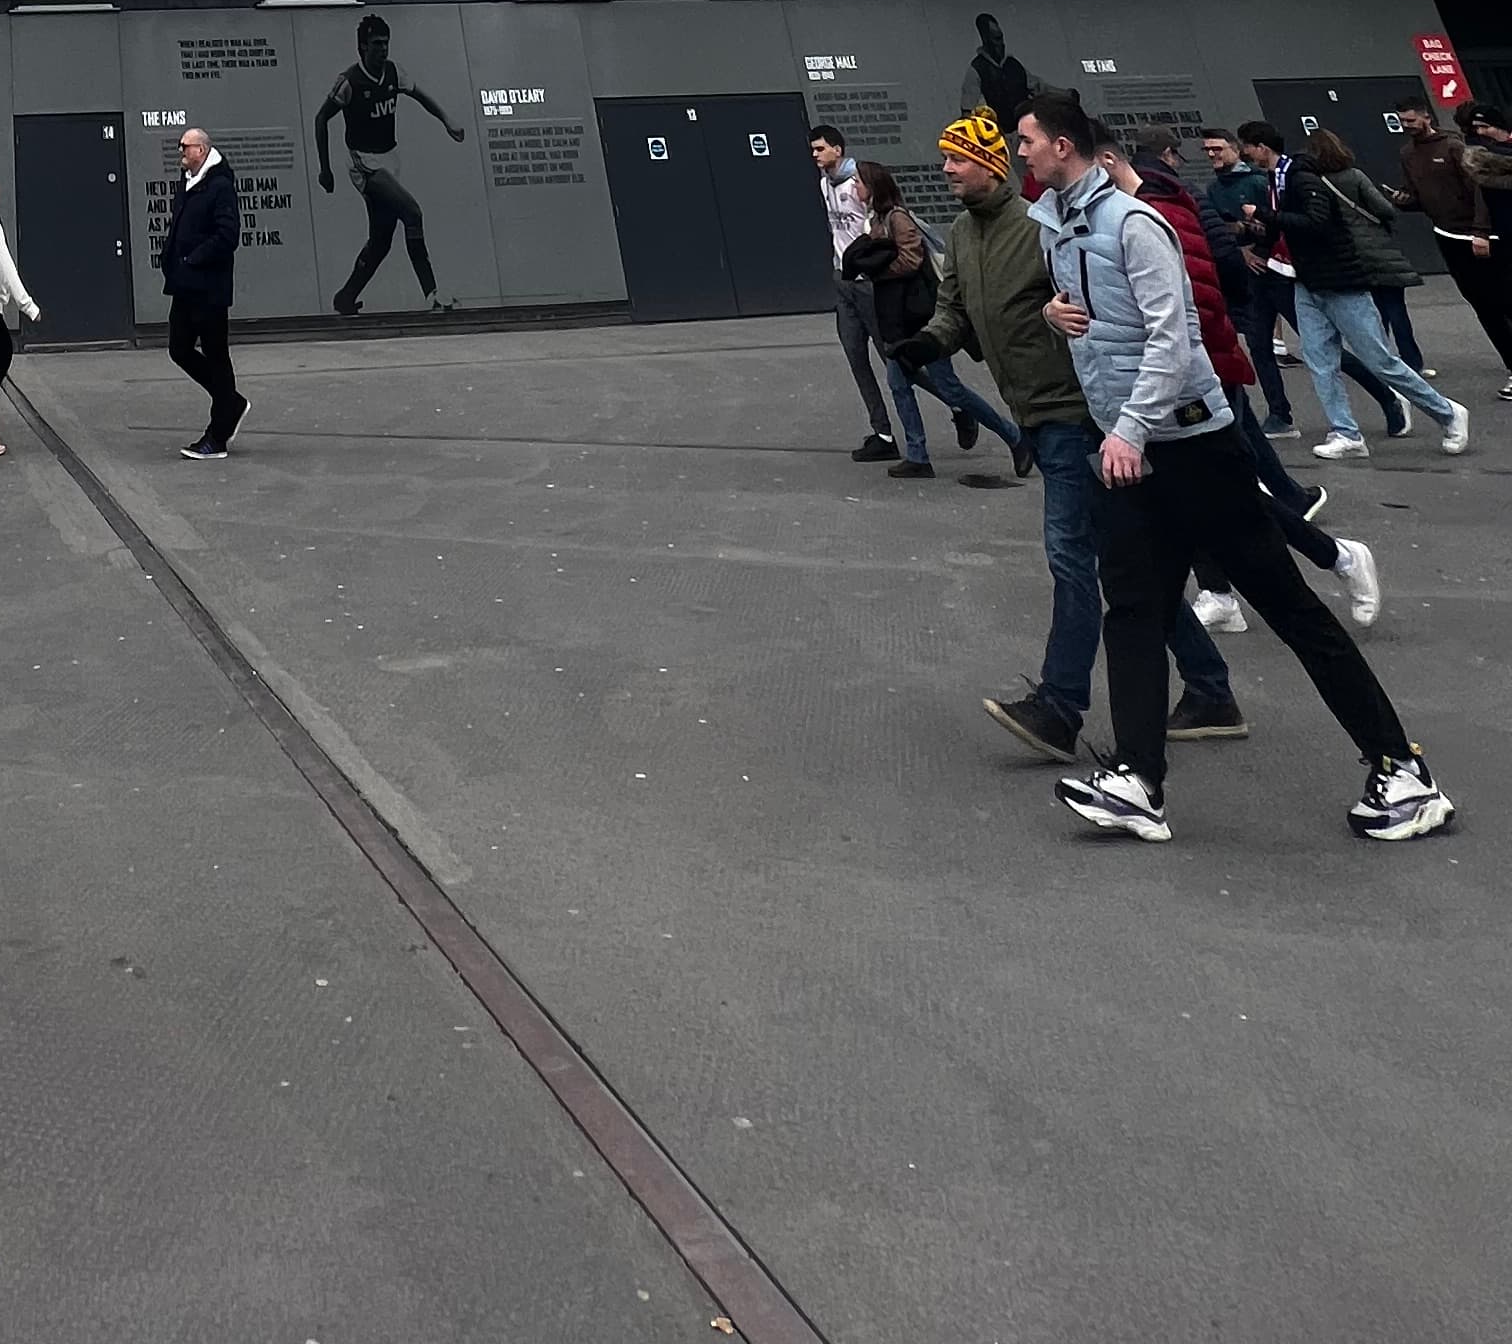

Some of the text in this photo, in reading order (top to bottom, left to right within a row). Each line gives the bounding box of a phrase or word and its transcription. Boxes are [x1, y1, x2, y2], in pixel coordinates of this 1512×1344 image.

[804, 55, 858, 70] GEORGE MALE
[1422, 52, 1455, 62] CHECK
[1081, 59, 1117, 73] THE FANS
[480, 88, 545, 105] DAVID O'LEARY
[370, 98, 397, 118] JVC
[142, 111, 187, 127] THE FANS
[103, 125, 115, 140] 14
[145, 181, 167, 196] HE'D
[256, 176, 278, 192] MAN
[148, 198, 167, 213] AND
[260, 193, 292, 209] MEANT
[148, 217, 162, 232] AS
[243, 213, 256, 228] TO
[241, 231, 254, 247] OF
[256, 230, 284, 246] FANS.
